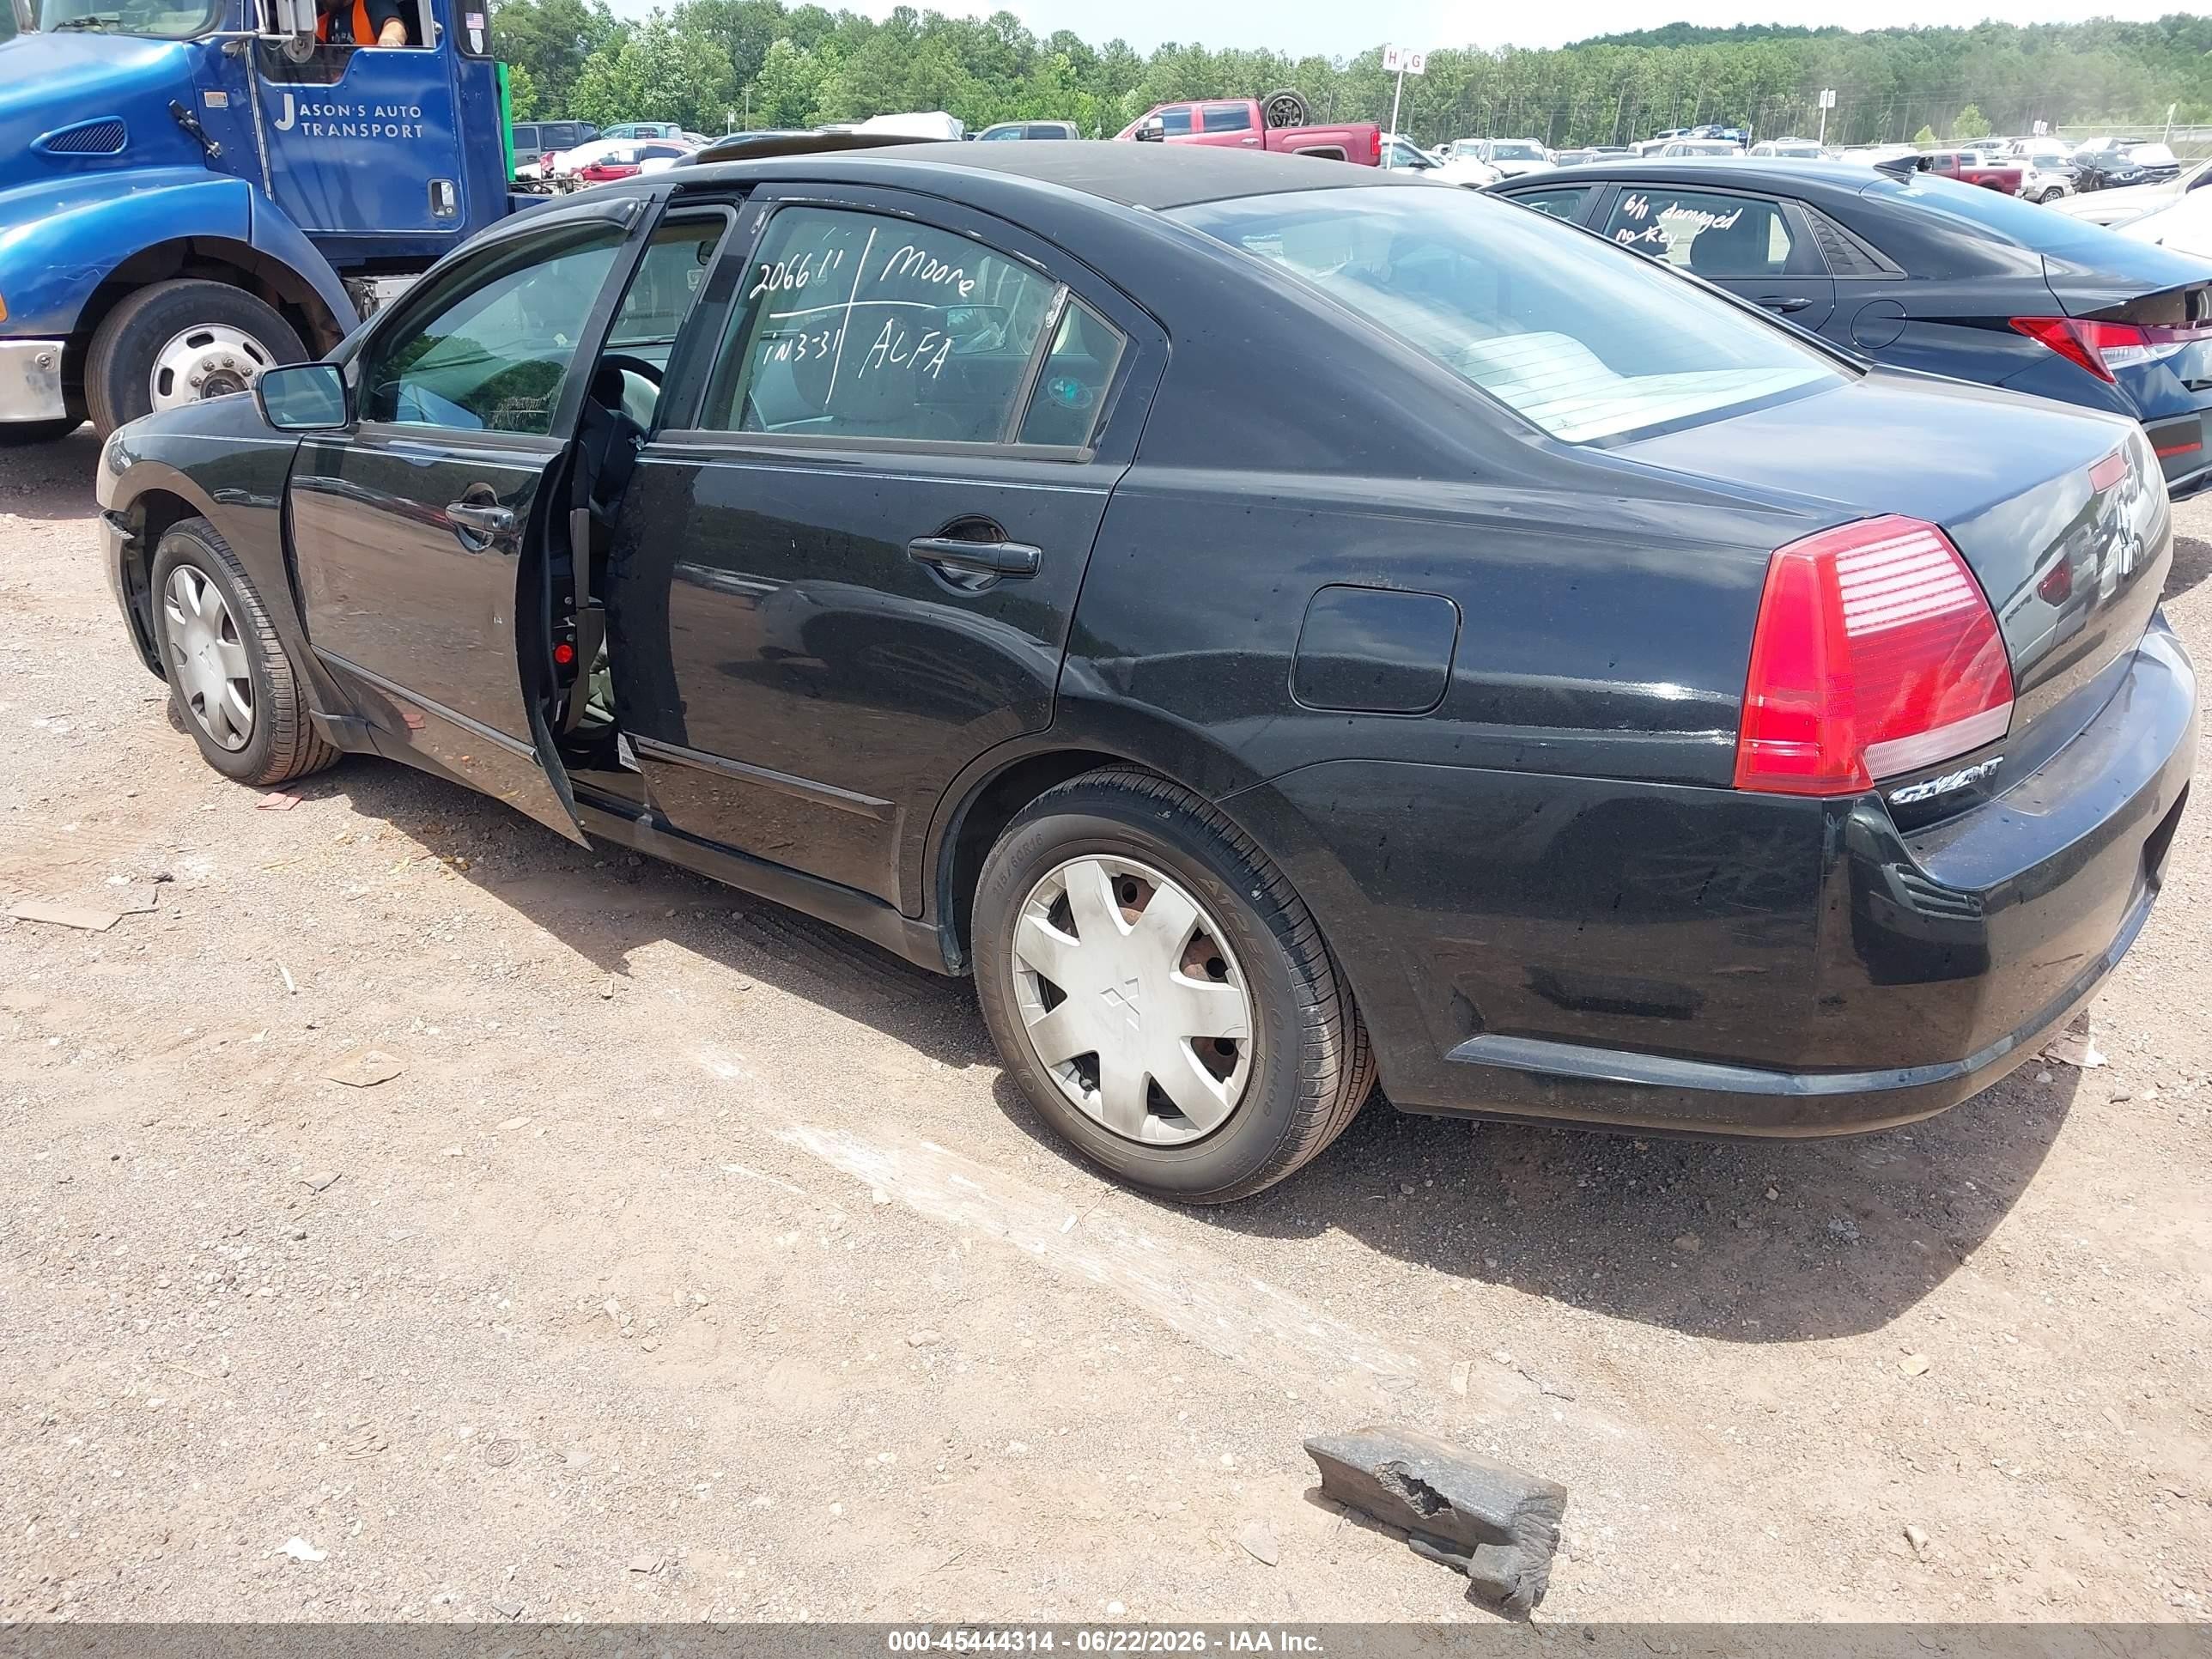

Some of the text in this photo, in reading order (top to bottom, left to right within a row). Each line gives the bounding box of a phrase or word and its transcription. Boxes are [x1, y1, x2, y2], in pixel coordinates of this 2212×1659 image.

[1388, 50, 1398, 64] H
[1411, 53, 1422, 68] G
[274, 92, 422, 131] JASON'S AUTO
[301, 122, 423, 138] TRANSPORT
[1624, 193, 1744, 235] 6/11 damaged
[858, 317, 952, 379] ALFA
